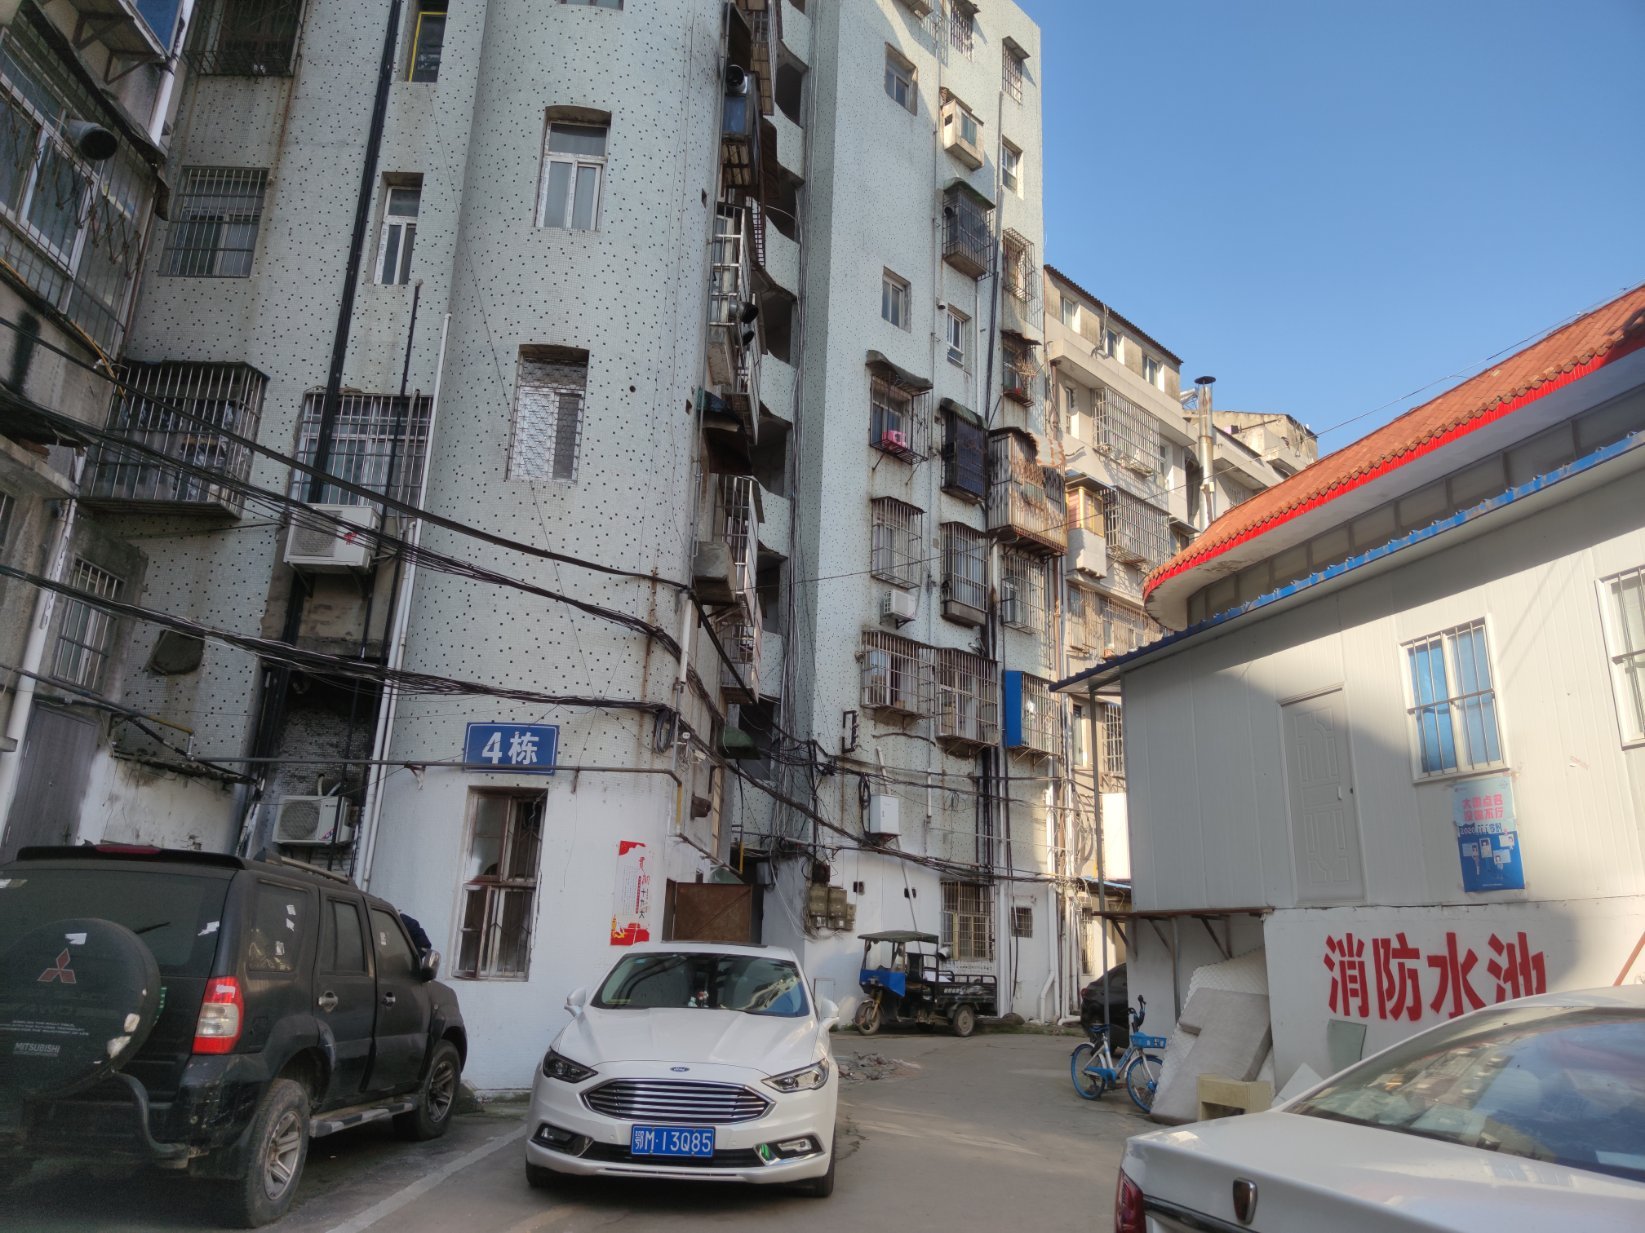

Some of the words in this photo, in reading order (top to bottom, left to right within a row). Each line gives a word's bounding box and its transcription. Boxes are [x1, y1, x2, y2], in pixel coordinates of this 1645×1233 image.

[482, 731, 539, 765] 4栋
[1323, 932, 1547, 1022] 消防水池
[14, 1042, 61, 1053] MITSUBISHI
